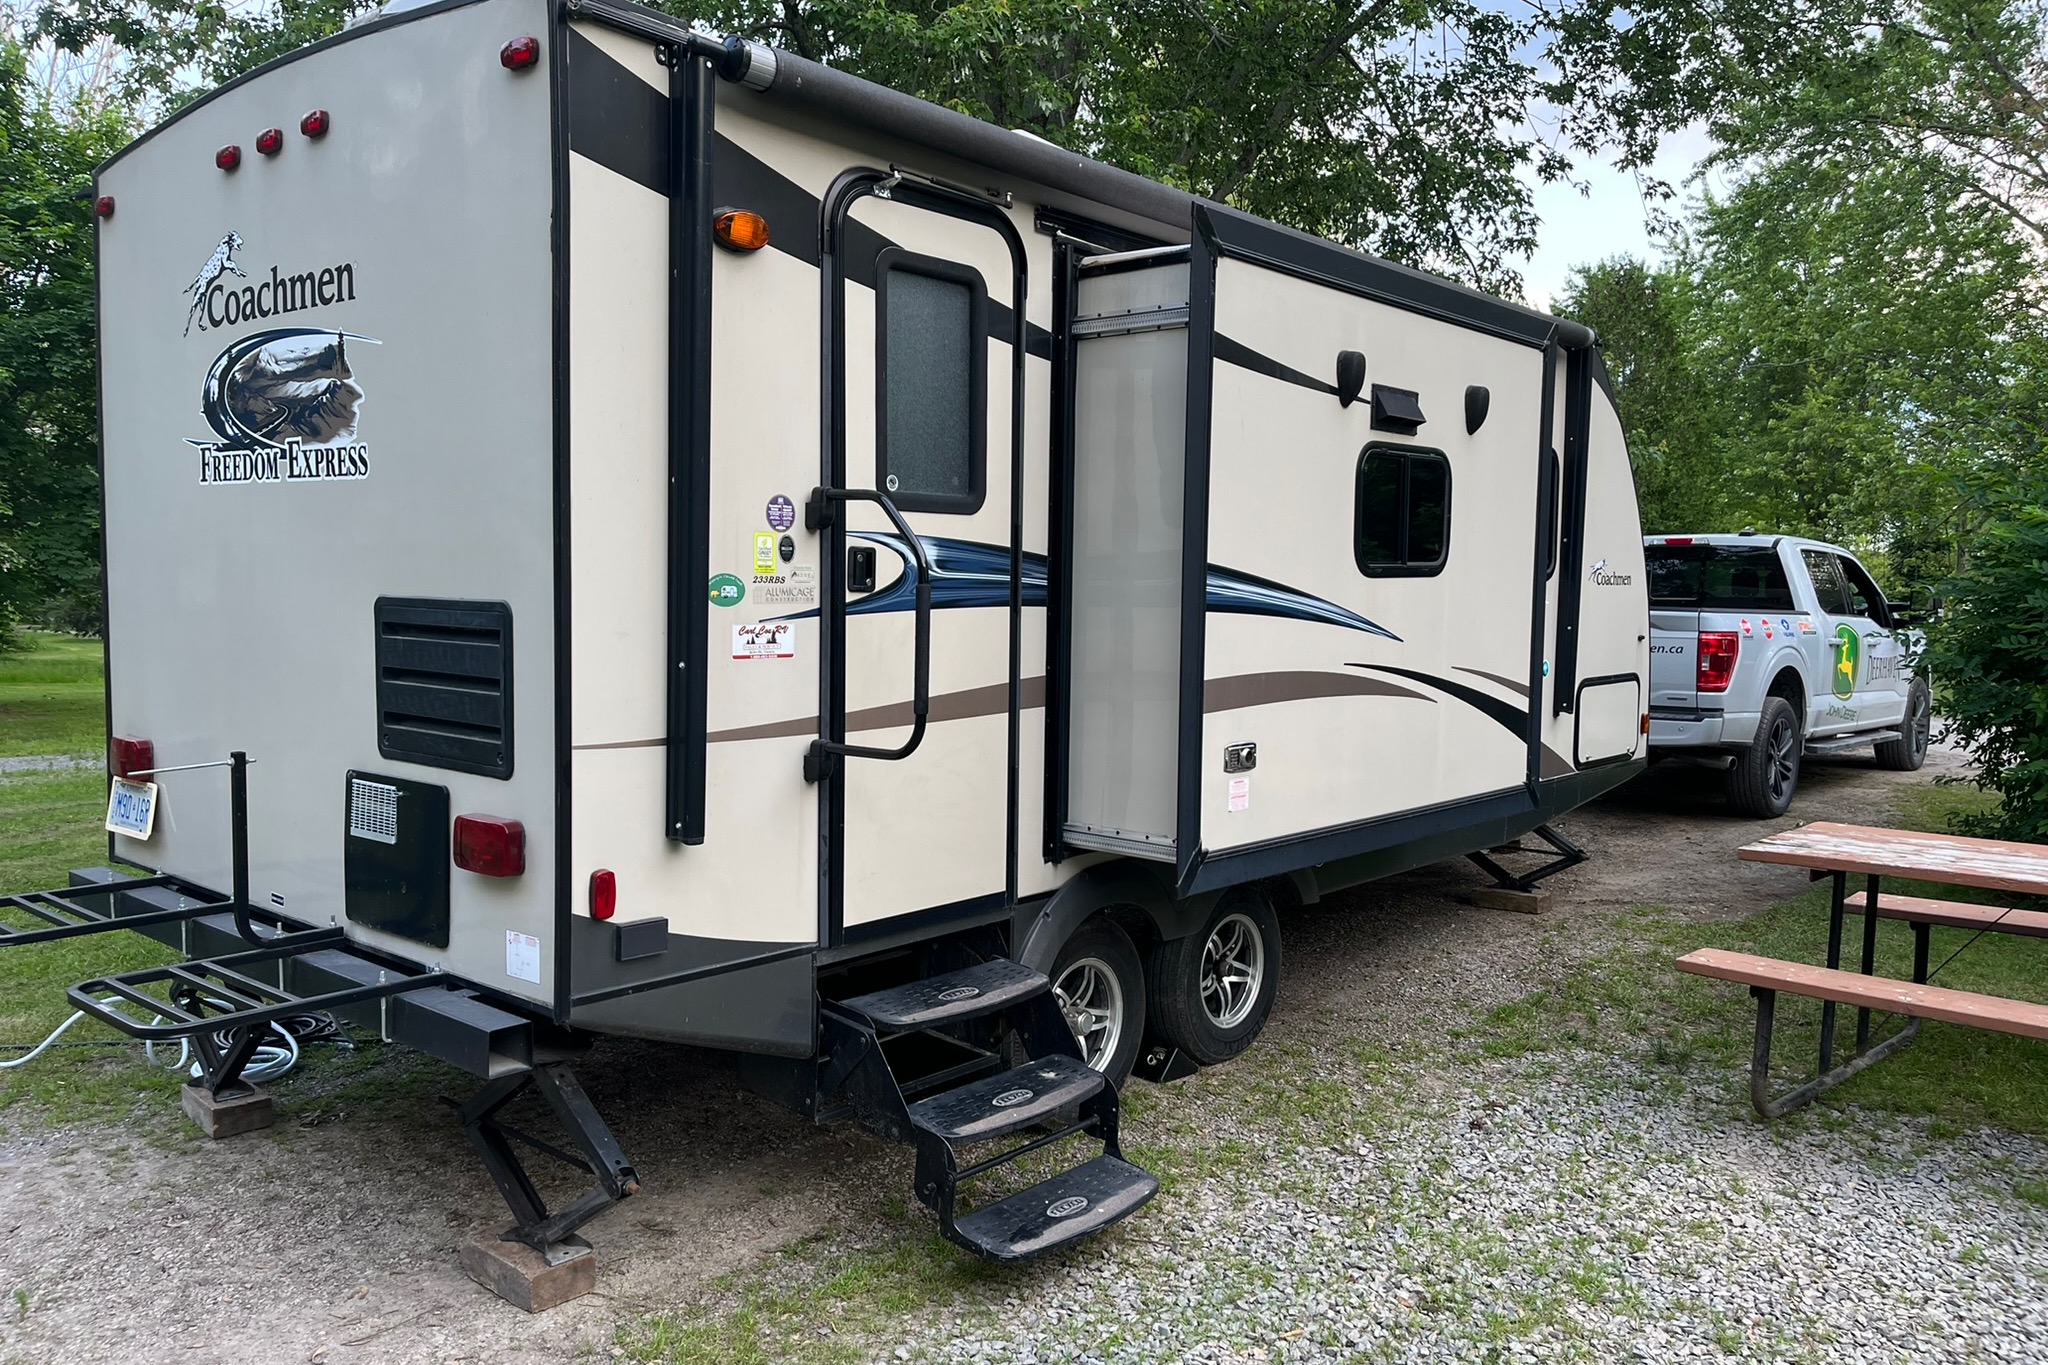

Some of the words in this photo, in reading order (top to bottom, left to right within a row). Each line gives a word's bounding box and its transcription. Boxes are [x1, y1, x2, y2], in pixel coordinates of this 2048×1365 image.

[207, 262, 356, 329] Coachmen
[200, 447, 280, 483] FREEDOM
[287, 441, 369, 479] EXPRESS
[752, 575, 786, 584] 233RBS
[1596, 571, 1632, 587] Coachmen
[765, 586, 815, 597] ALUMICAGE
[775, 625, 789, 635] RV
